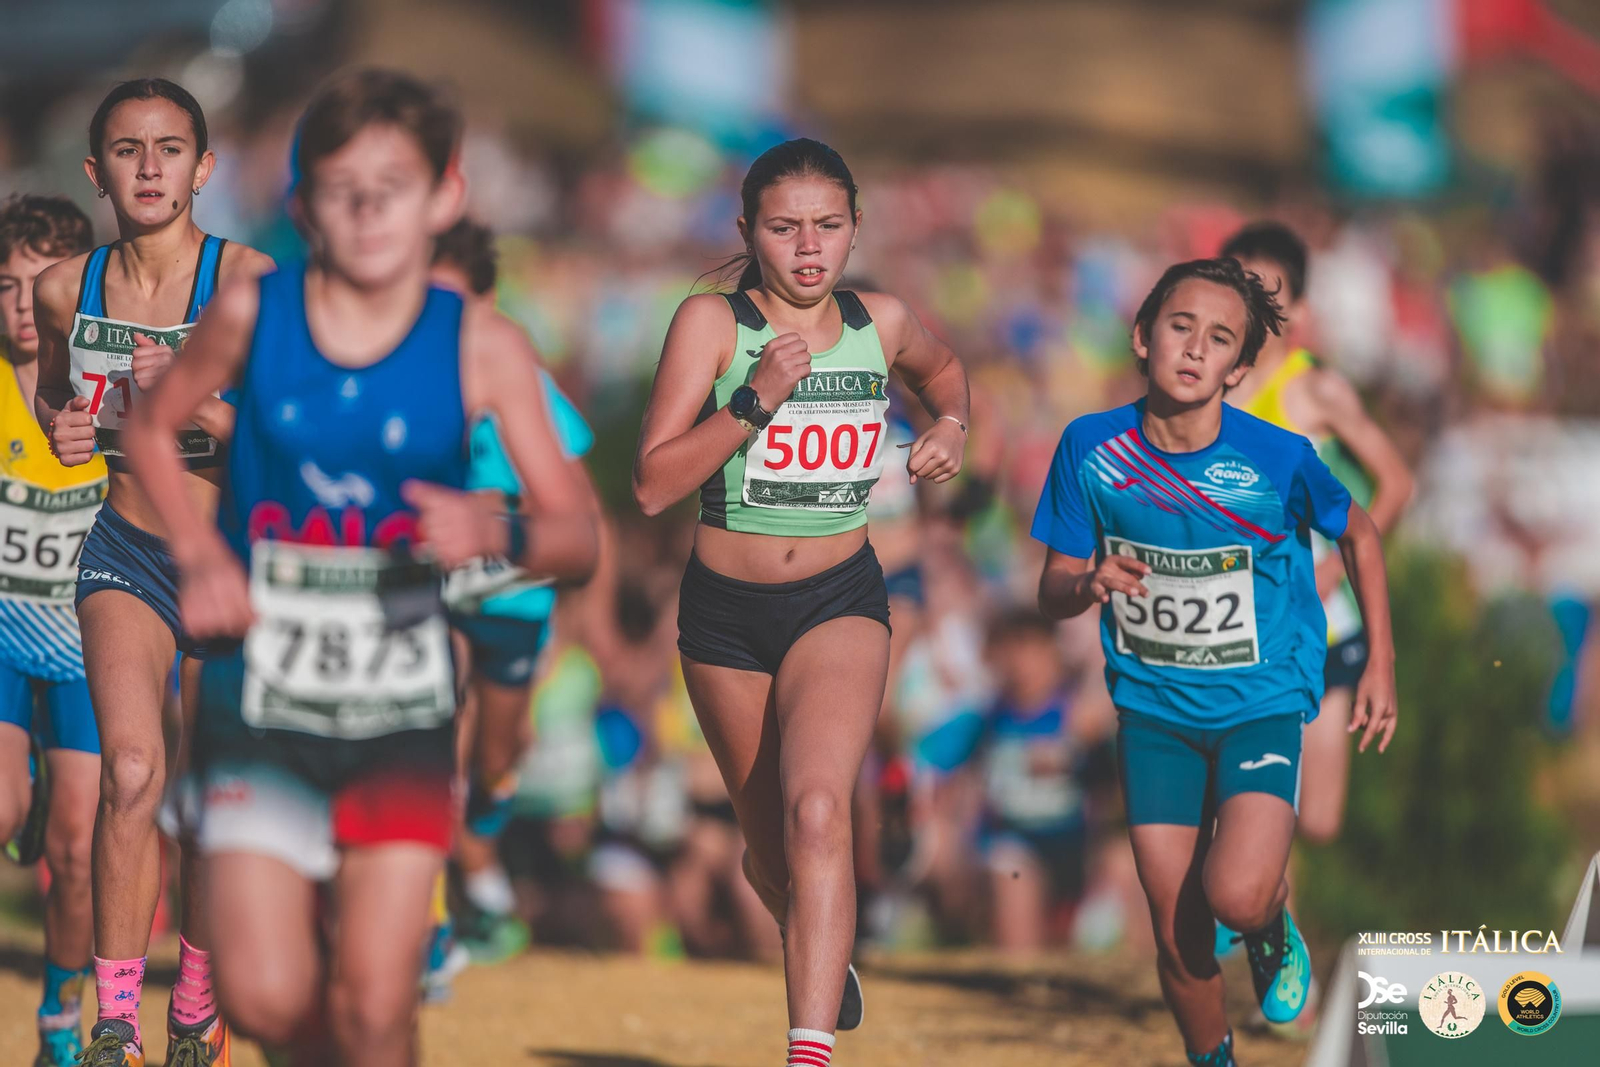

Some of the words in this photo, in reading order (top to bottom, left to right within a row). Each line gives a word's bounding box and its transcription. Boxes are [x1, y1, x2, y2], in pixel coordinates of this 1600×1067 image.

[797, 373, 863, 393] ITÁLICA
[763, 422, 882, 470] 5007
[2, 526, 88, 569] 567
[1125, 592, 1244, 634] 5622
